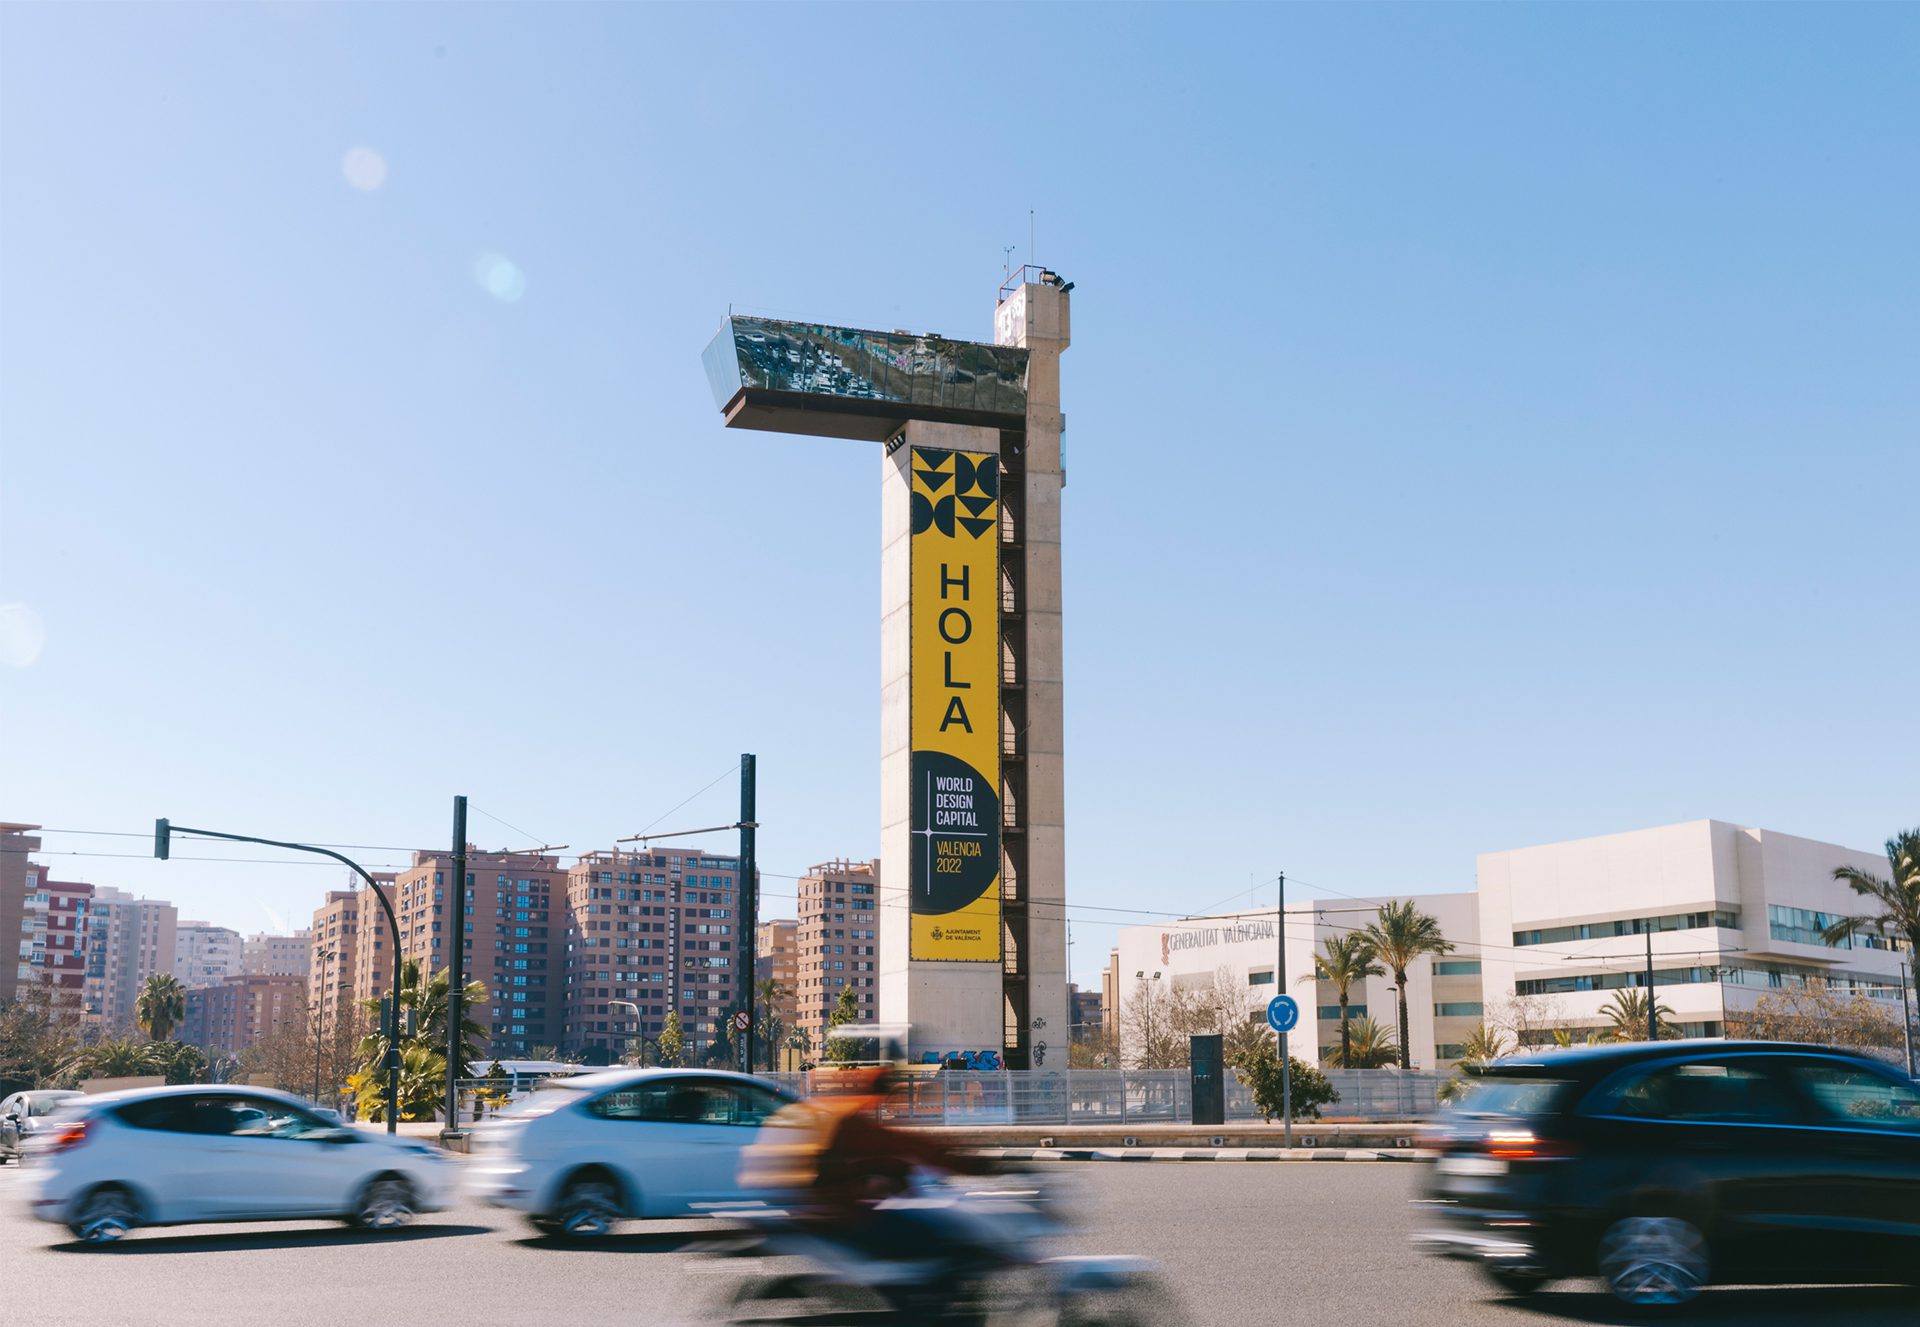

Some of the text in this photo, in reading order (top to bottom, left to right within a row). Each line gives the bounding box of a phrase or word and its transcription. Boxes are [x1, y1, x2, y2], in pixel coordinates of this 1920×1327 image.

[938, 563, 973, 734] HOLA
[936, 776, 973, 792] WORLD
[936, 794, 973, 809] DESIGN
[936, 811, 978, 826] CAPITAL
[936, 841, 981, 856] VALENCIA
[936, 858, 962, 873] 2022
[1170, 921, 1275, 951] GENERALITAT VALENCIANA
